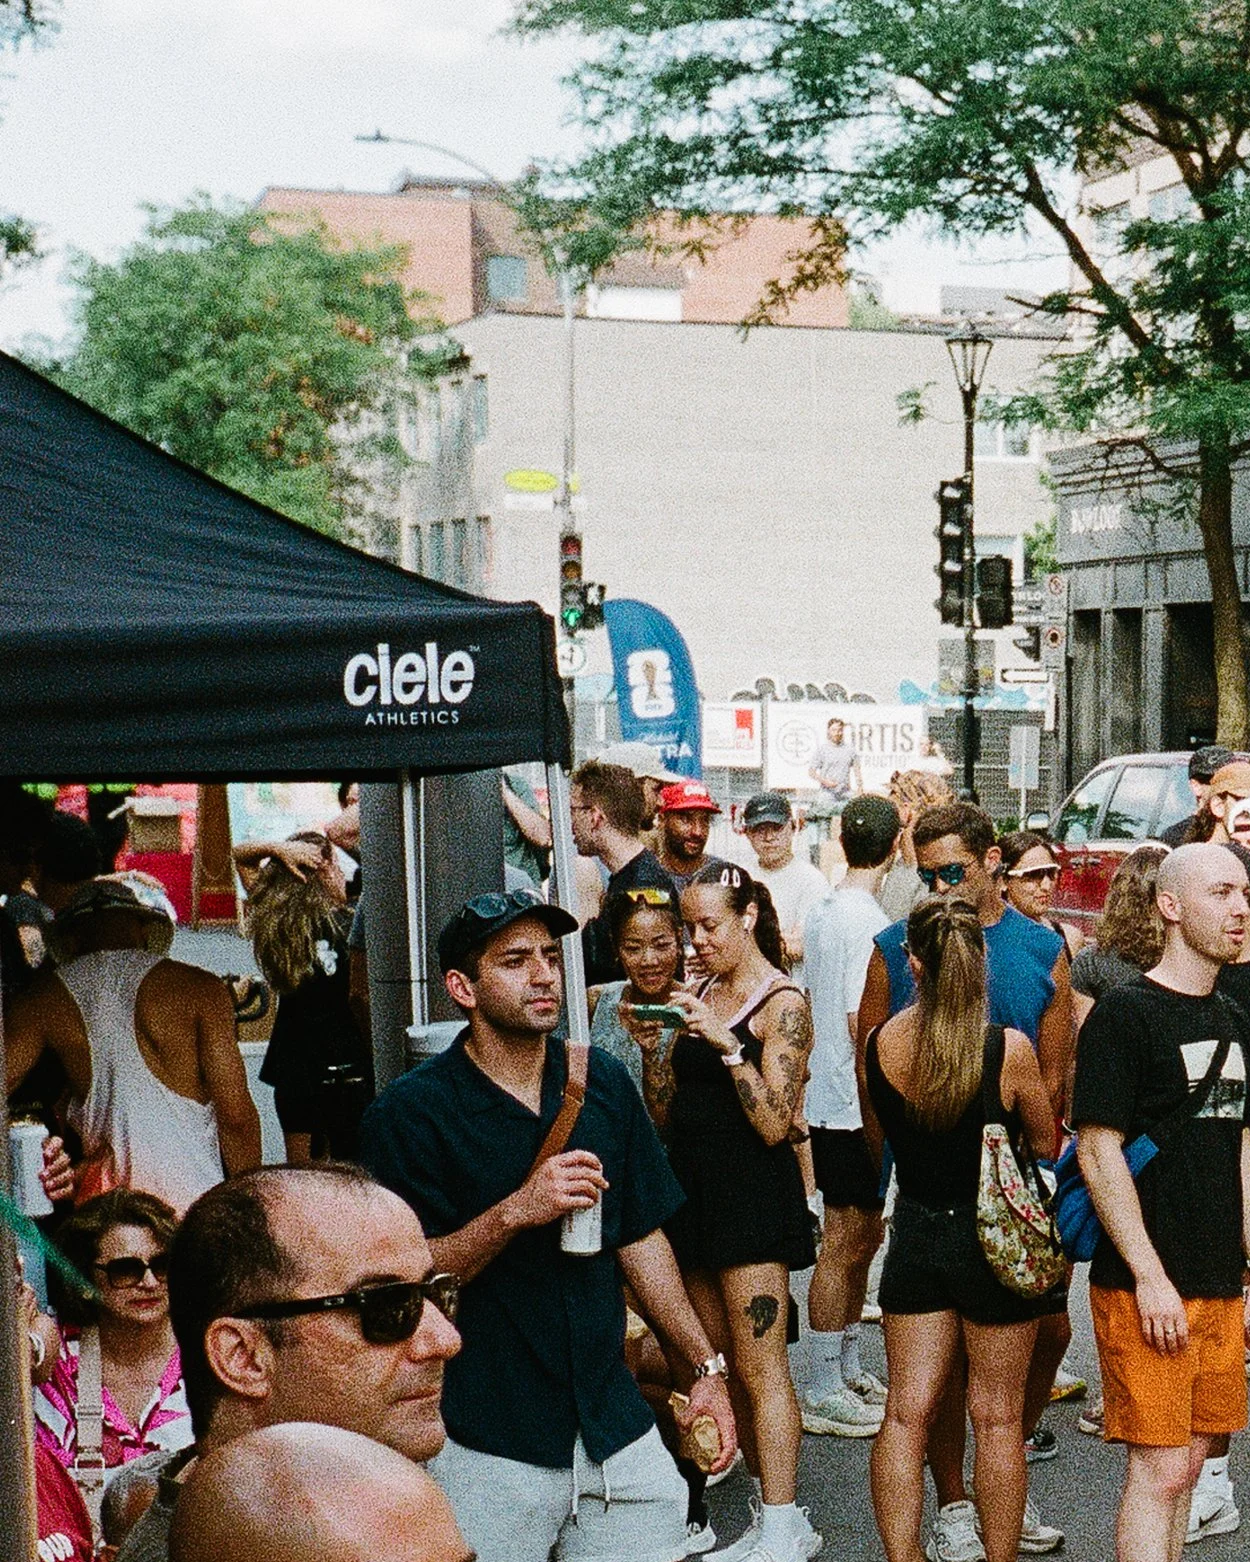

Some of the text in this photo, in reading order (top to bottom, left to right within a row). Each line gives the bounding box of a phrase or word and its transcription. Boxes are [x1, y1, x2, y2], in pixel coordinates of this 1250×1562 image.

[364, 710, 460, 726] ATHLETICS
[845, 722, 914, 753] RTIS
[656, 742, 693, 759] TRA
